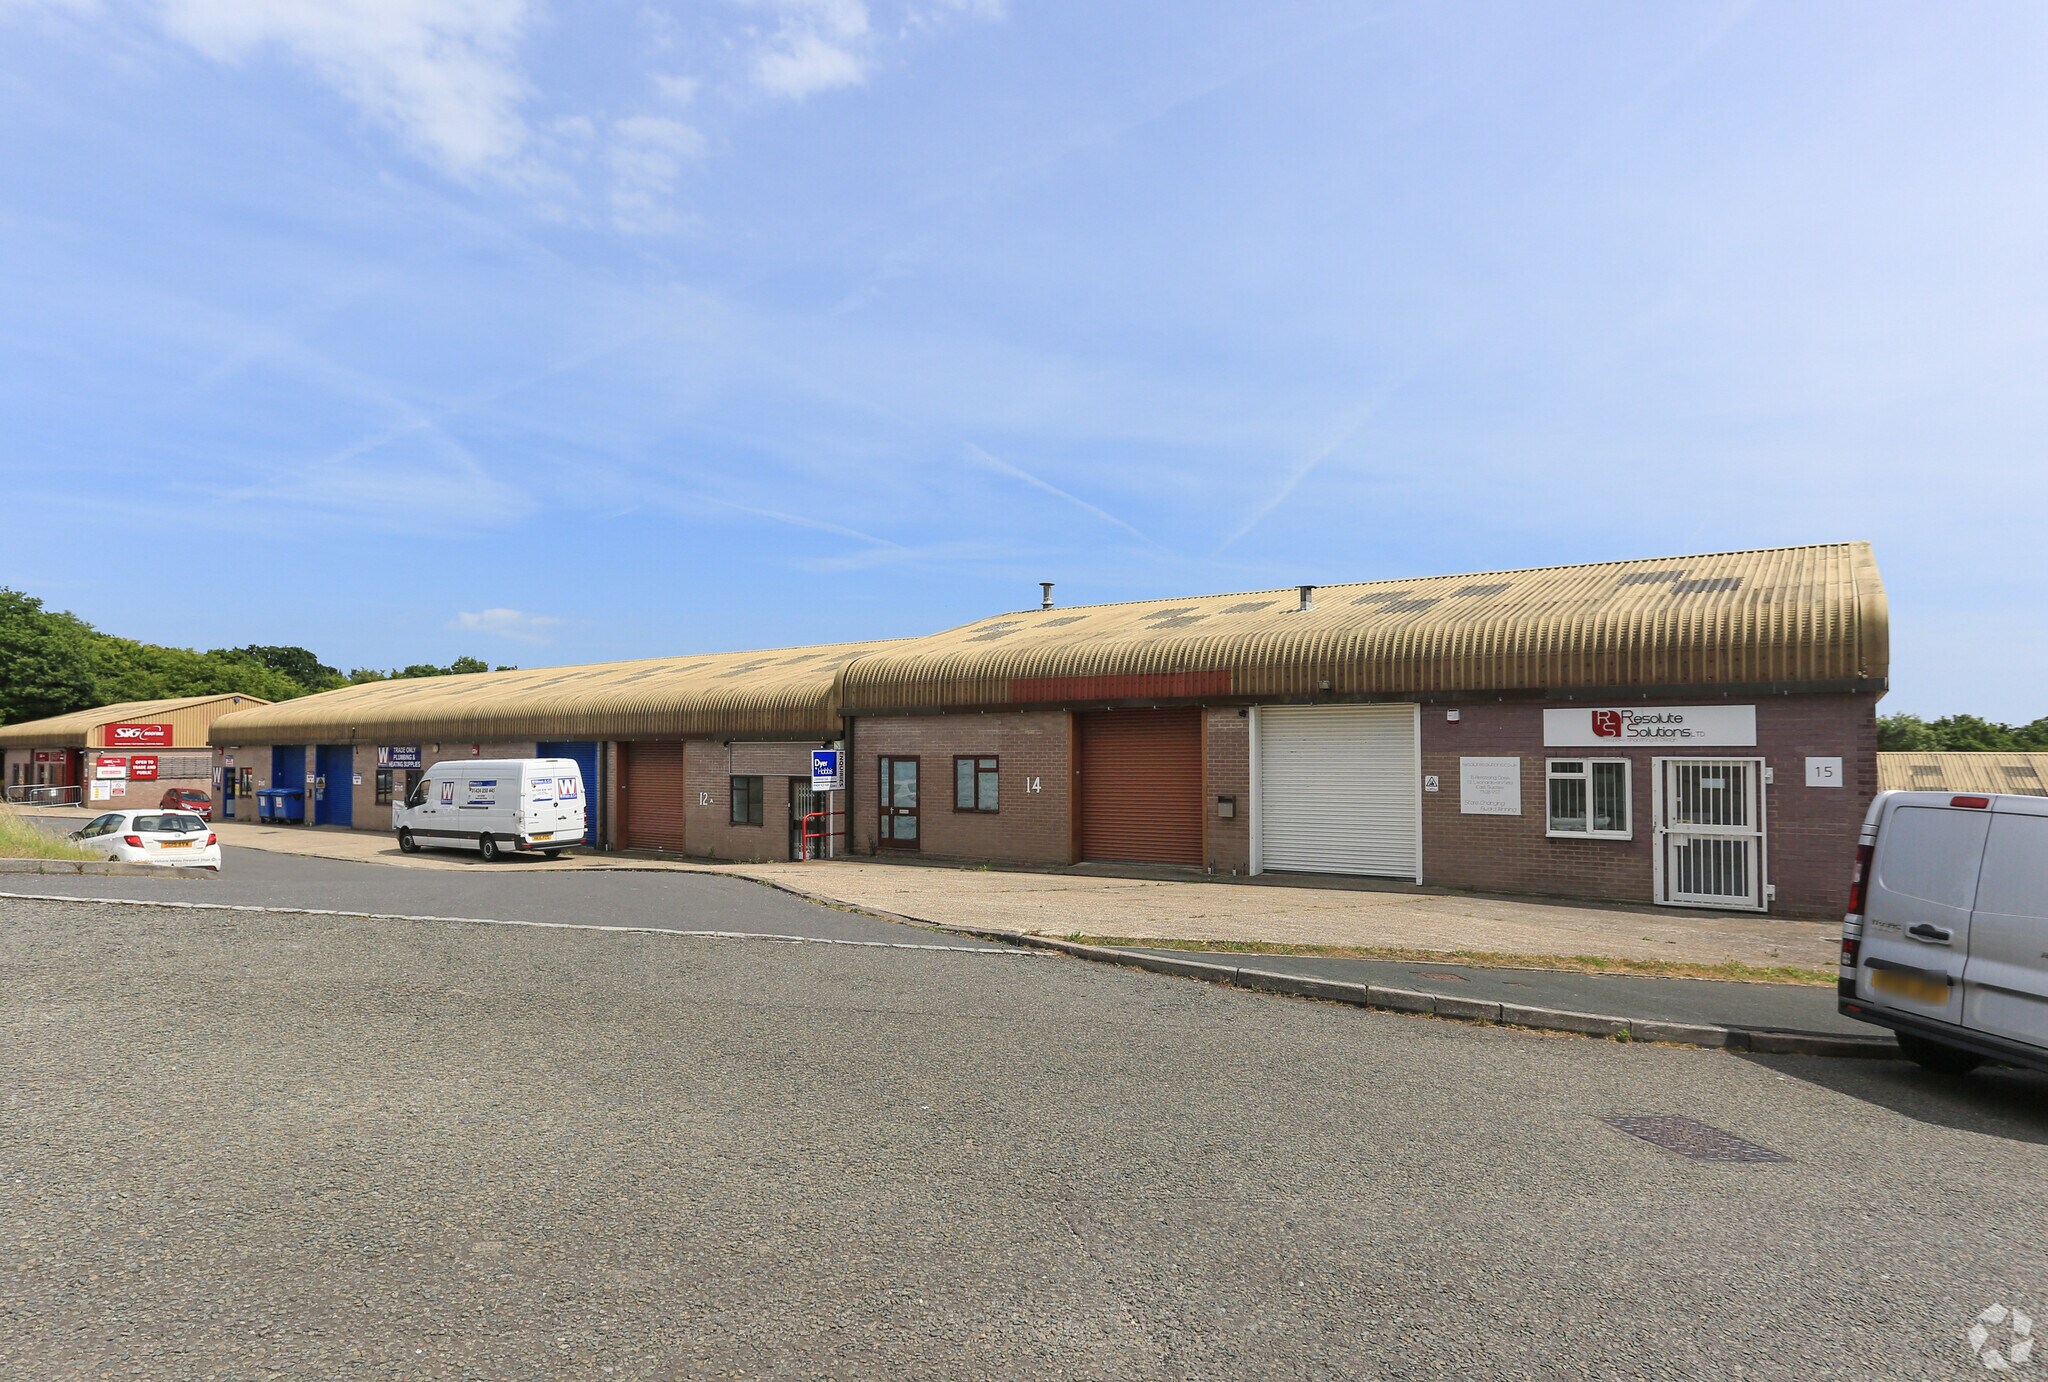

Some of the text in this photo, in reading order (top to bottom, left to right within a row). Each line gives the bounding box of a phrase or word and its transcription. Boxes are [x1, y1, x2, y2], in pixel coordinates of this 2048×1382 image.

[1621, 710, 1683, 724] Resolute
[114, 727, 141, 738] SIG
[1627, 723, 1691, 738] Solutions
[814, 759, 828, 769] Dyer
[1815, 766, 1833, 778] 15
[442, 783, 454, 800] W
[558, 778, 576, 795] W
[1026, 776, 1042, 793] 14
[699, 791, 708, 806] 12
